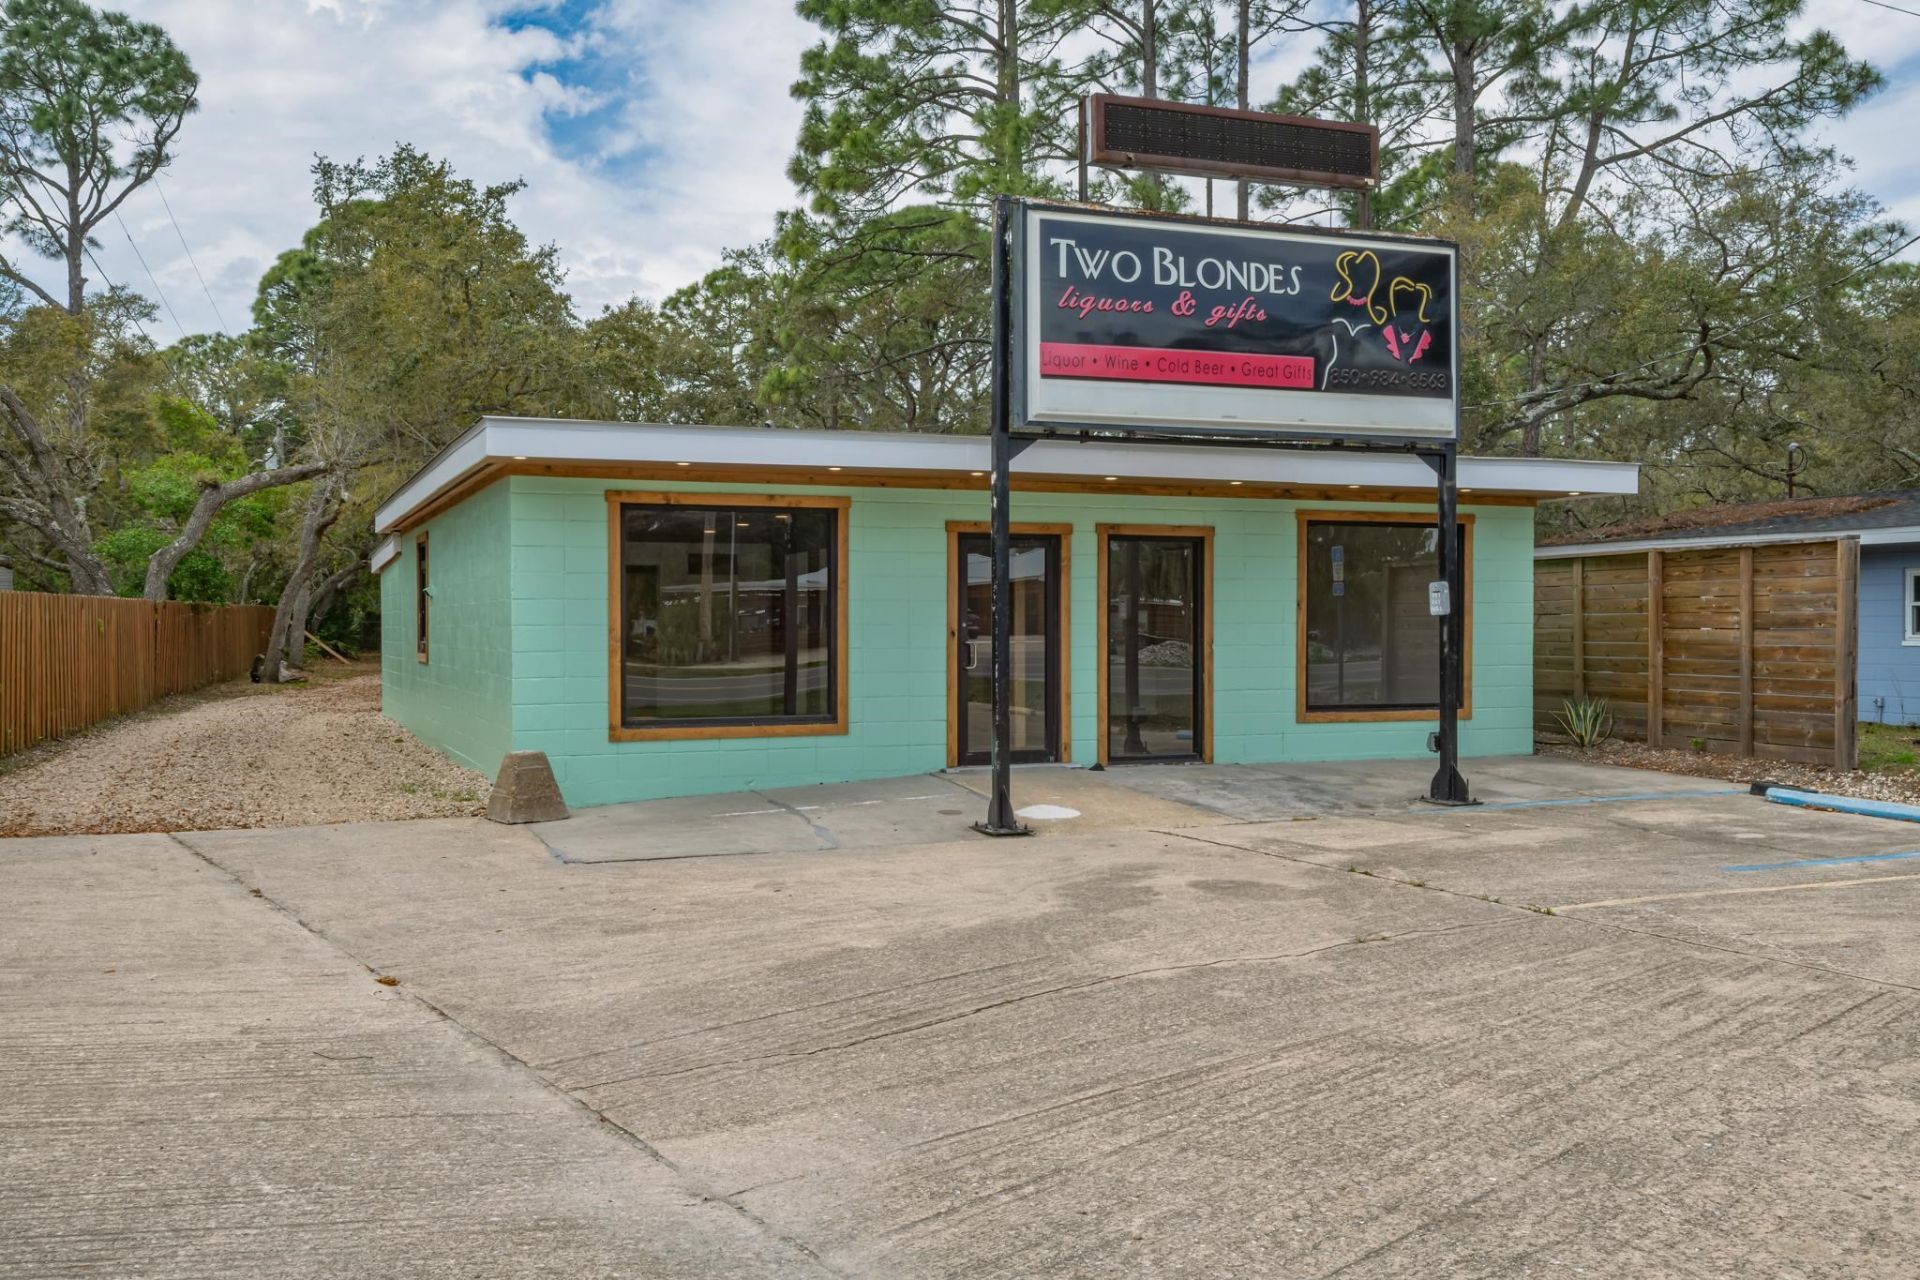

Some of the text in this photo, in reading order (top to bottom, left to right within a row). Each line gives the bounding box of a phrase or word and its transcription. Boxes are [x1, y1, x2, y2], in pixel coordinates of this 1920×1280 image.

[1050, 237, 1303, 296] TWO BLONDES
[1057, 285, 1268, 329] liquors & gifts
[1041, 350, 1313, 380] Liquor Wine Cold Beer Great Gifts
